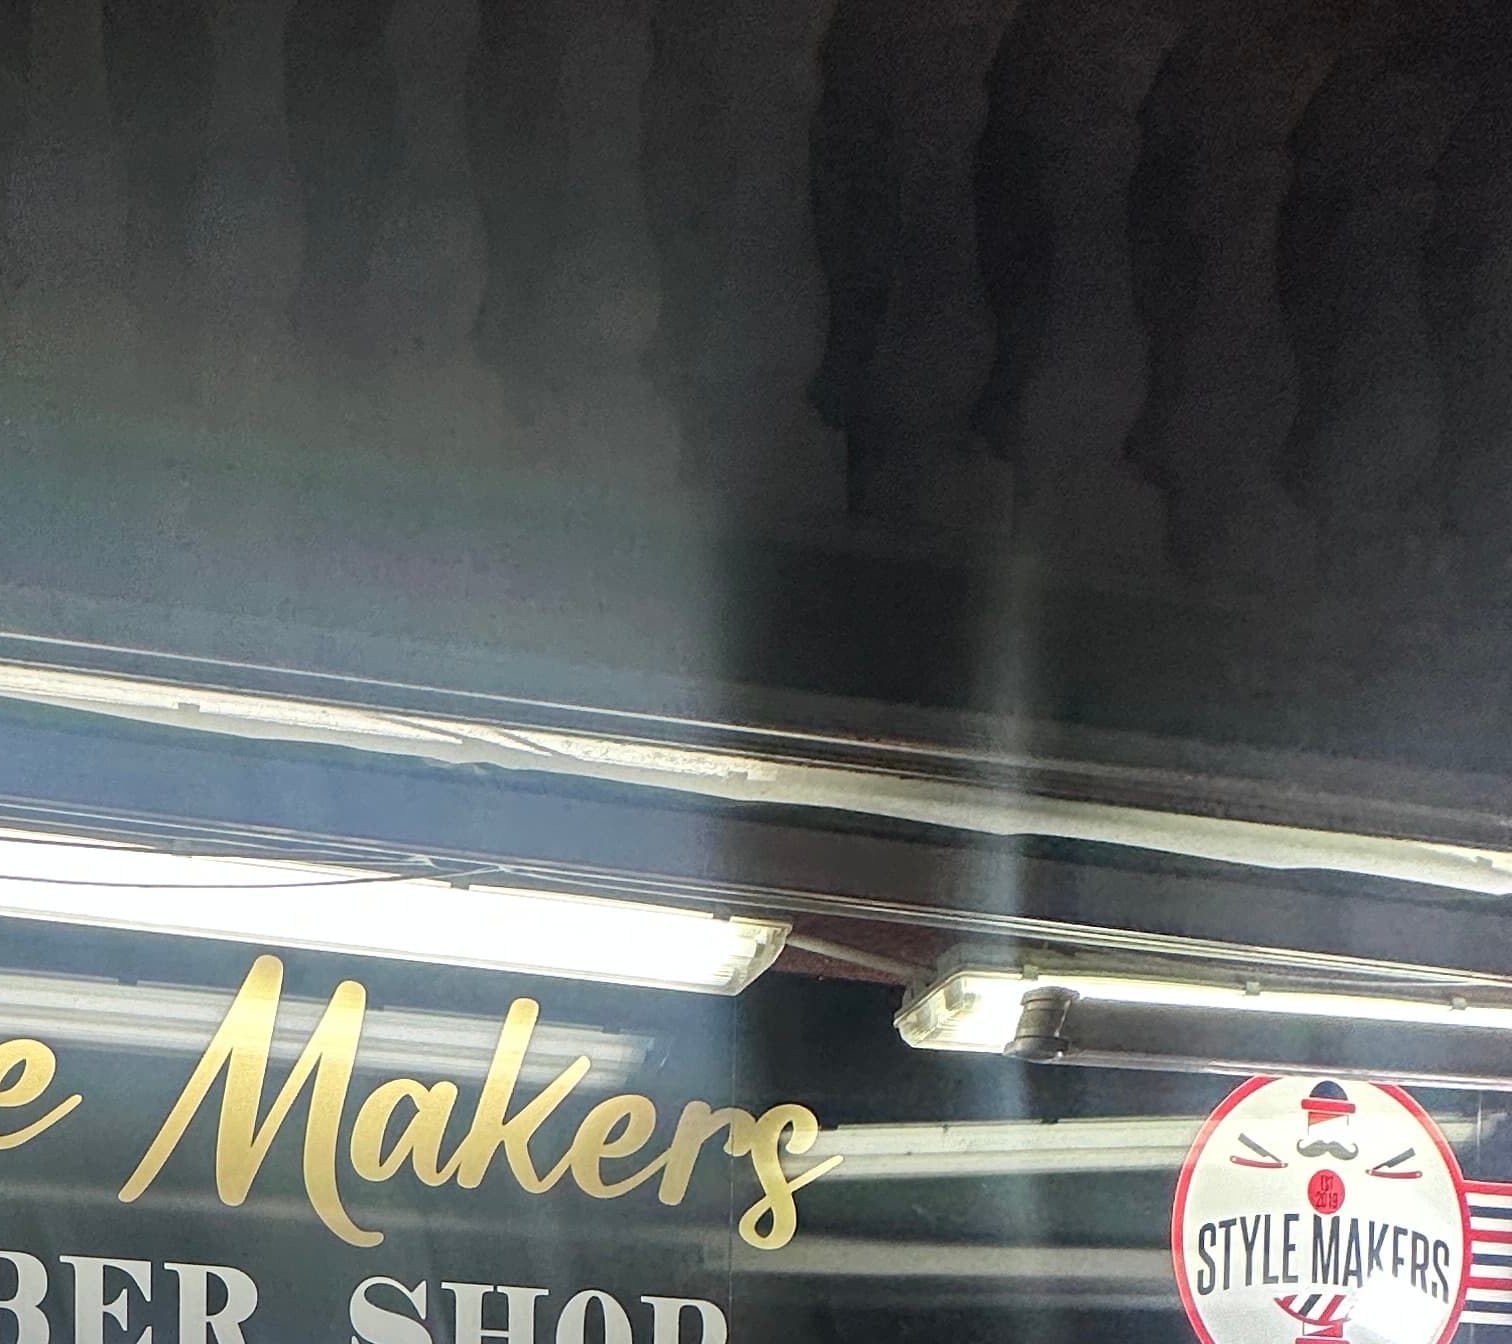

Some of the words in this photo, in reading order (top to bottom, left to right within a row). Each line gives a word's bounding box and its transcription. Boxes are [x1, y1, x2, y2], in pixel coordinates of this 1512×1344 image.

[118, 954, 844, 1250] Makers
[1196, 1213, 1300, 1296] STYLE
[1311, 1214, 1450, 1305] MAKERS
